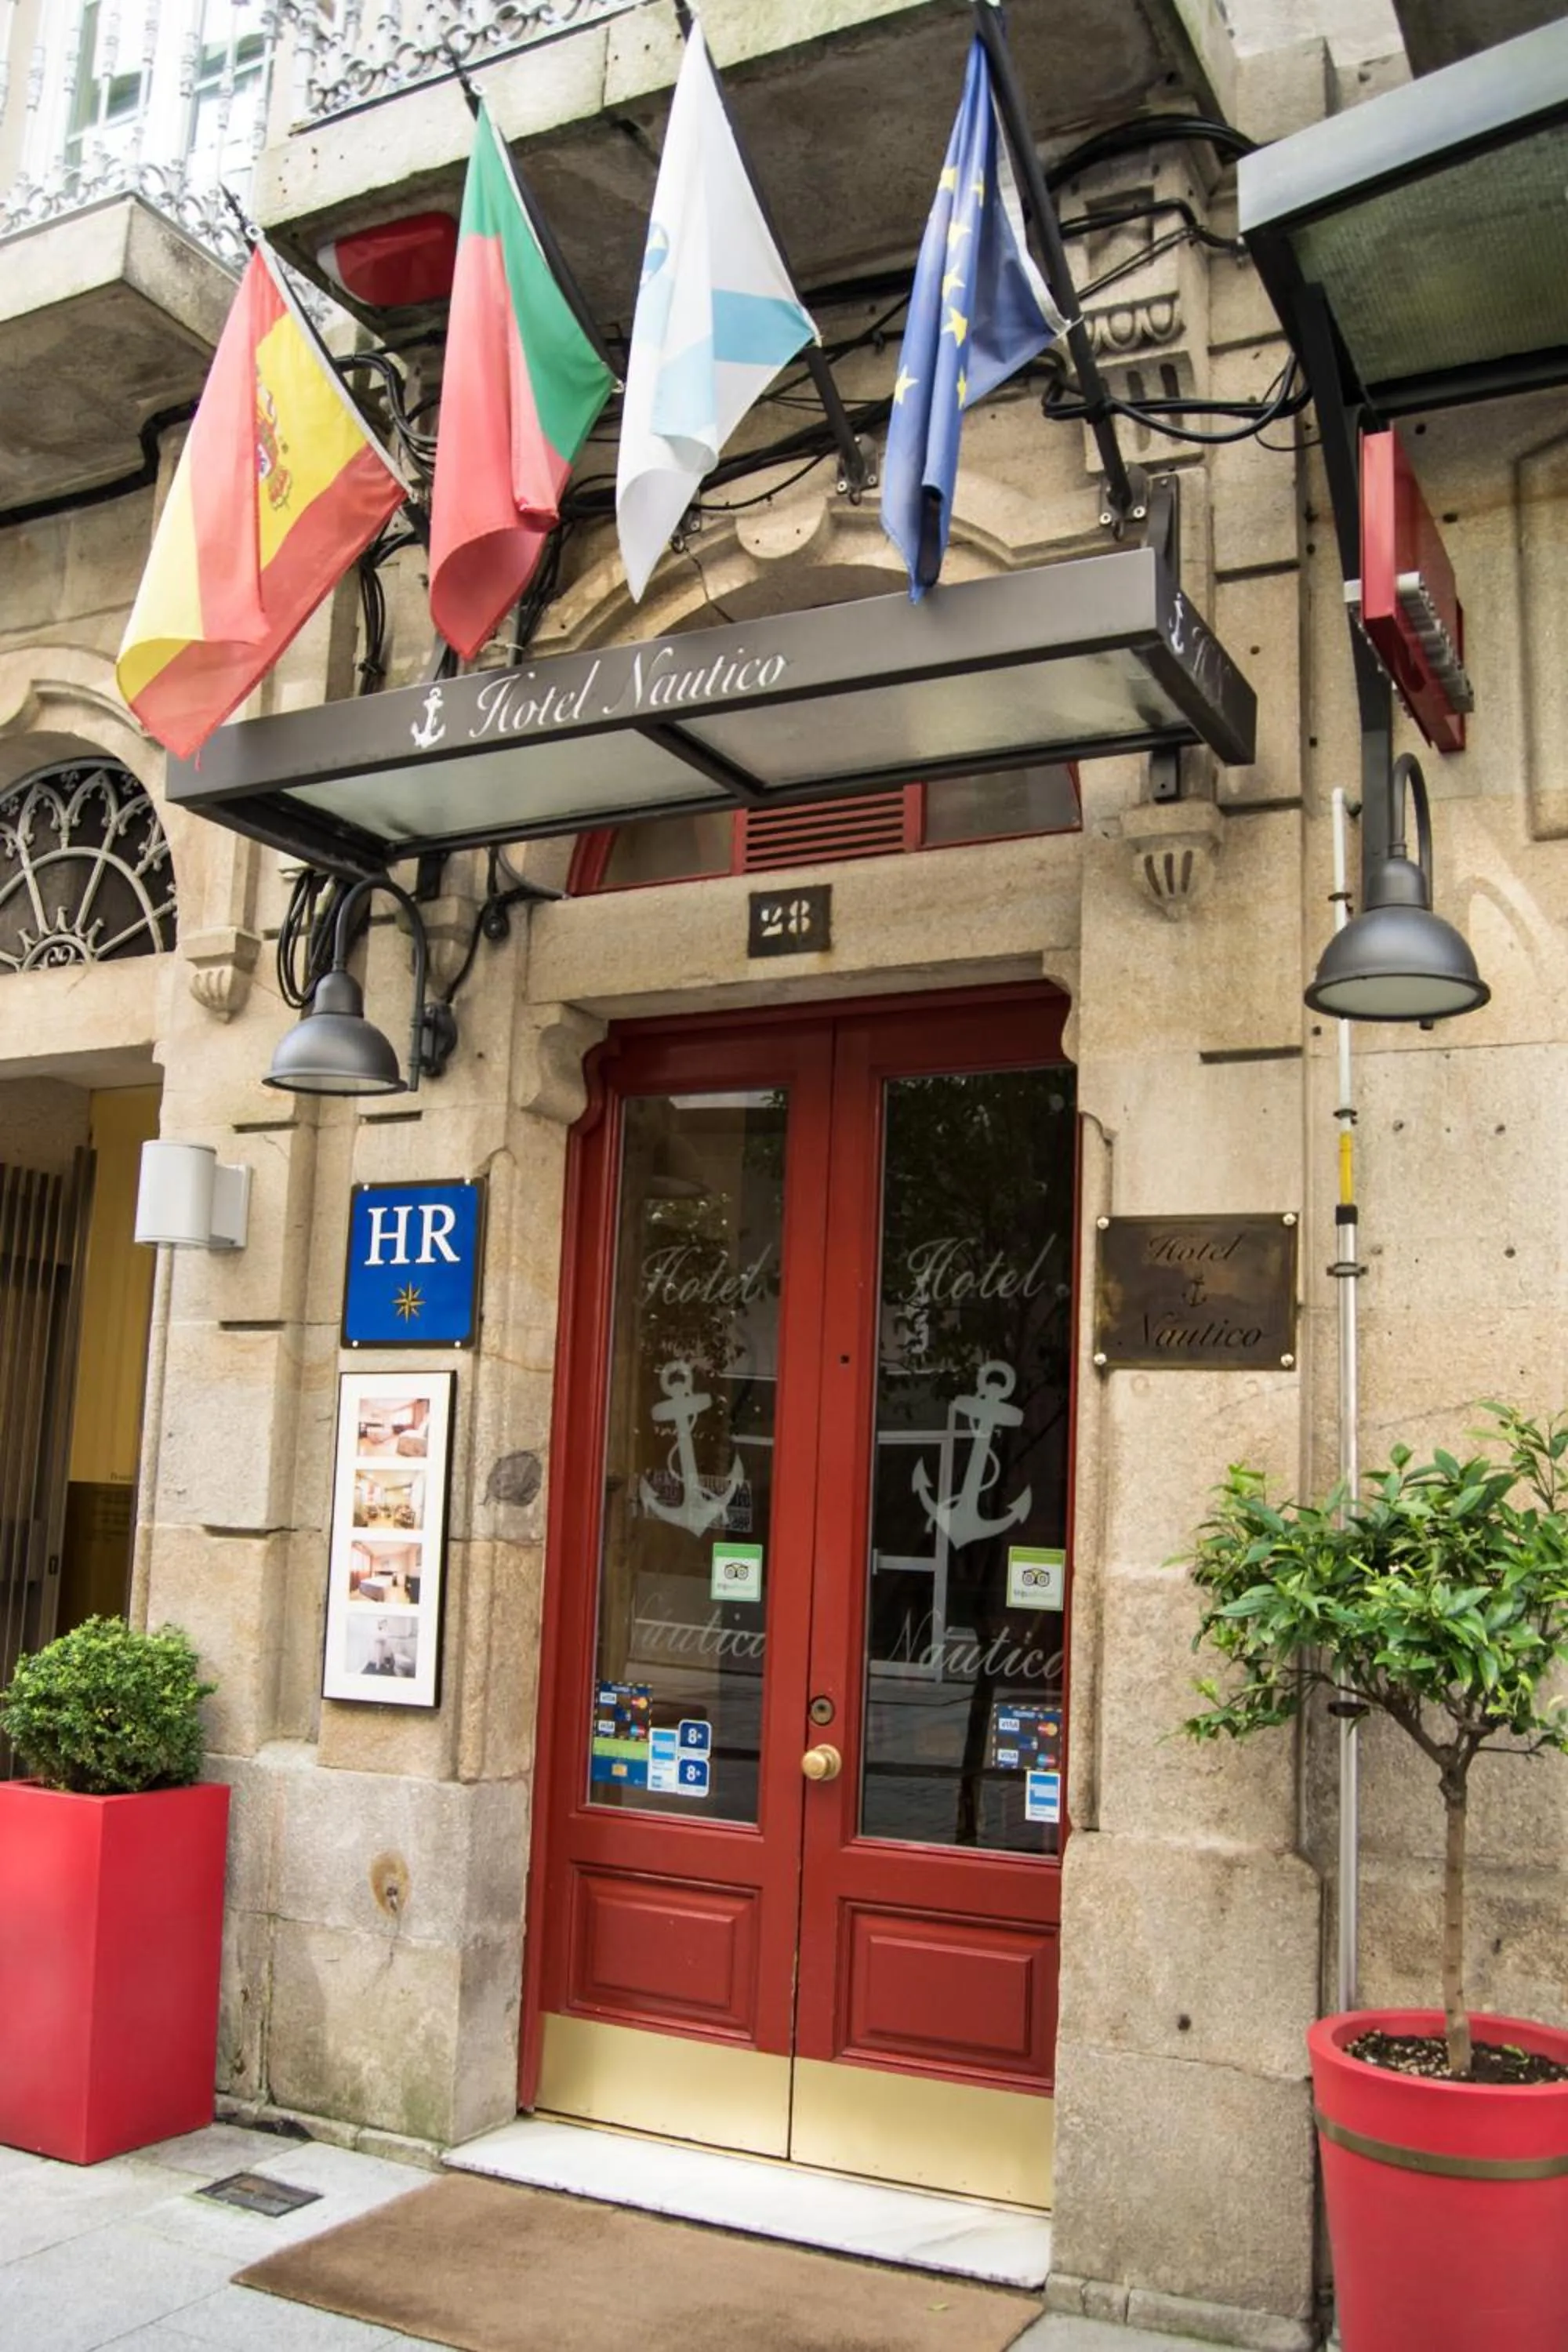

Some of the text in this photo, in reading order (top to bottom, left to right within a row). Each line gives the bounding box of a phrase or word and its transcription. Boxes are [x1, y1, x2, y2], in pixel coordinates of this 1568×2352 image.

[469, 647, 787, 739] Hotel Nautico
[760, 899, 811, 938] 28
[364, 1203, 461, 1265] HR
[1148, 1232, 1248, 1262] Hotel
[637, 1243, 772, 1306] Hotel
[899, 1233, 1057, 1301] Hotel
